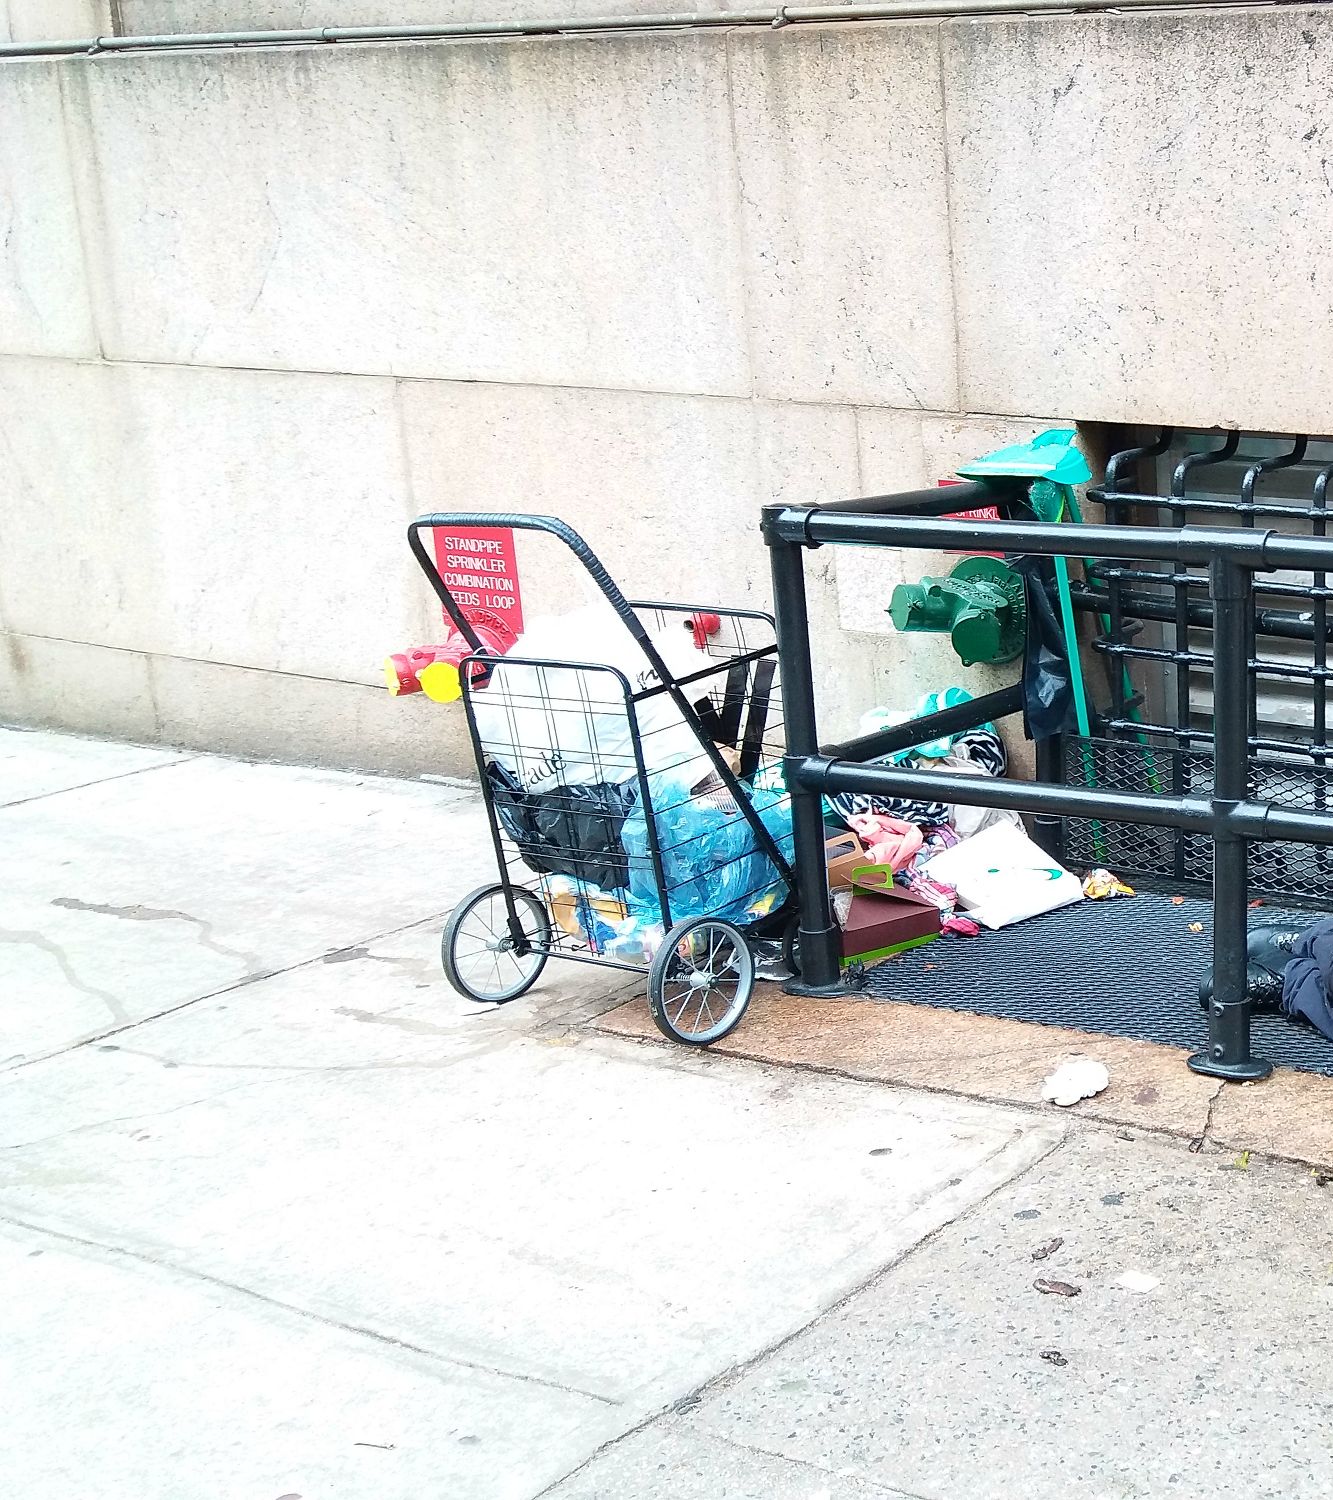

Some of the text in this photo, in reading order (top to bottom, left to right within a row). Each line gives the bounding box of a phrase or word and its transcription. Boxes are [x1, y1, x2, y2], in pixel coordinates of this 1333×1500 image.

[444, 536, 504, 555] STANDPIPE
[446, 555, 506, 573] SPRINKLER
[443, 572, 514, 592] COMBINATION
[485, 594, 516, 609] LOOP
